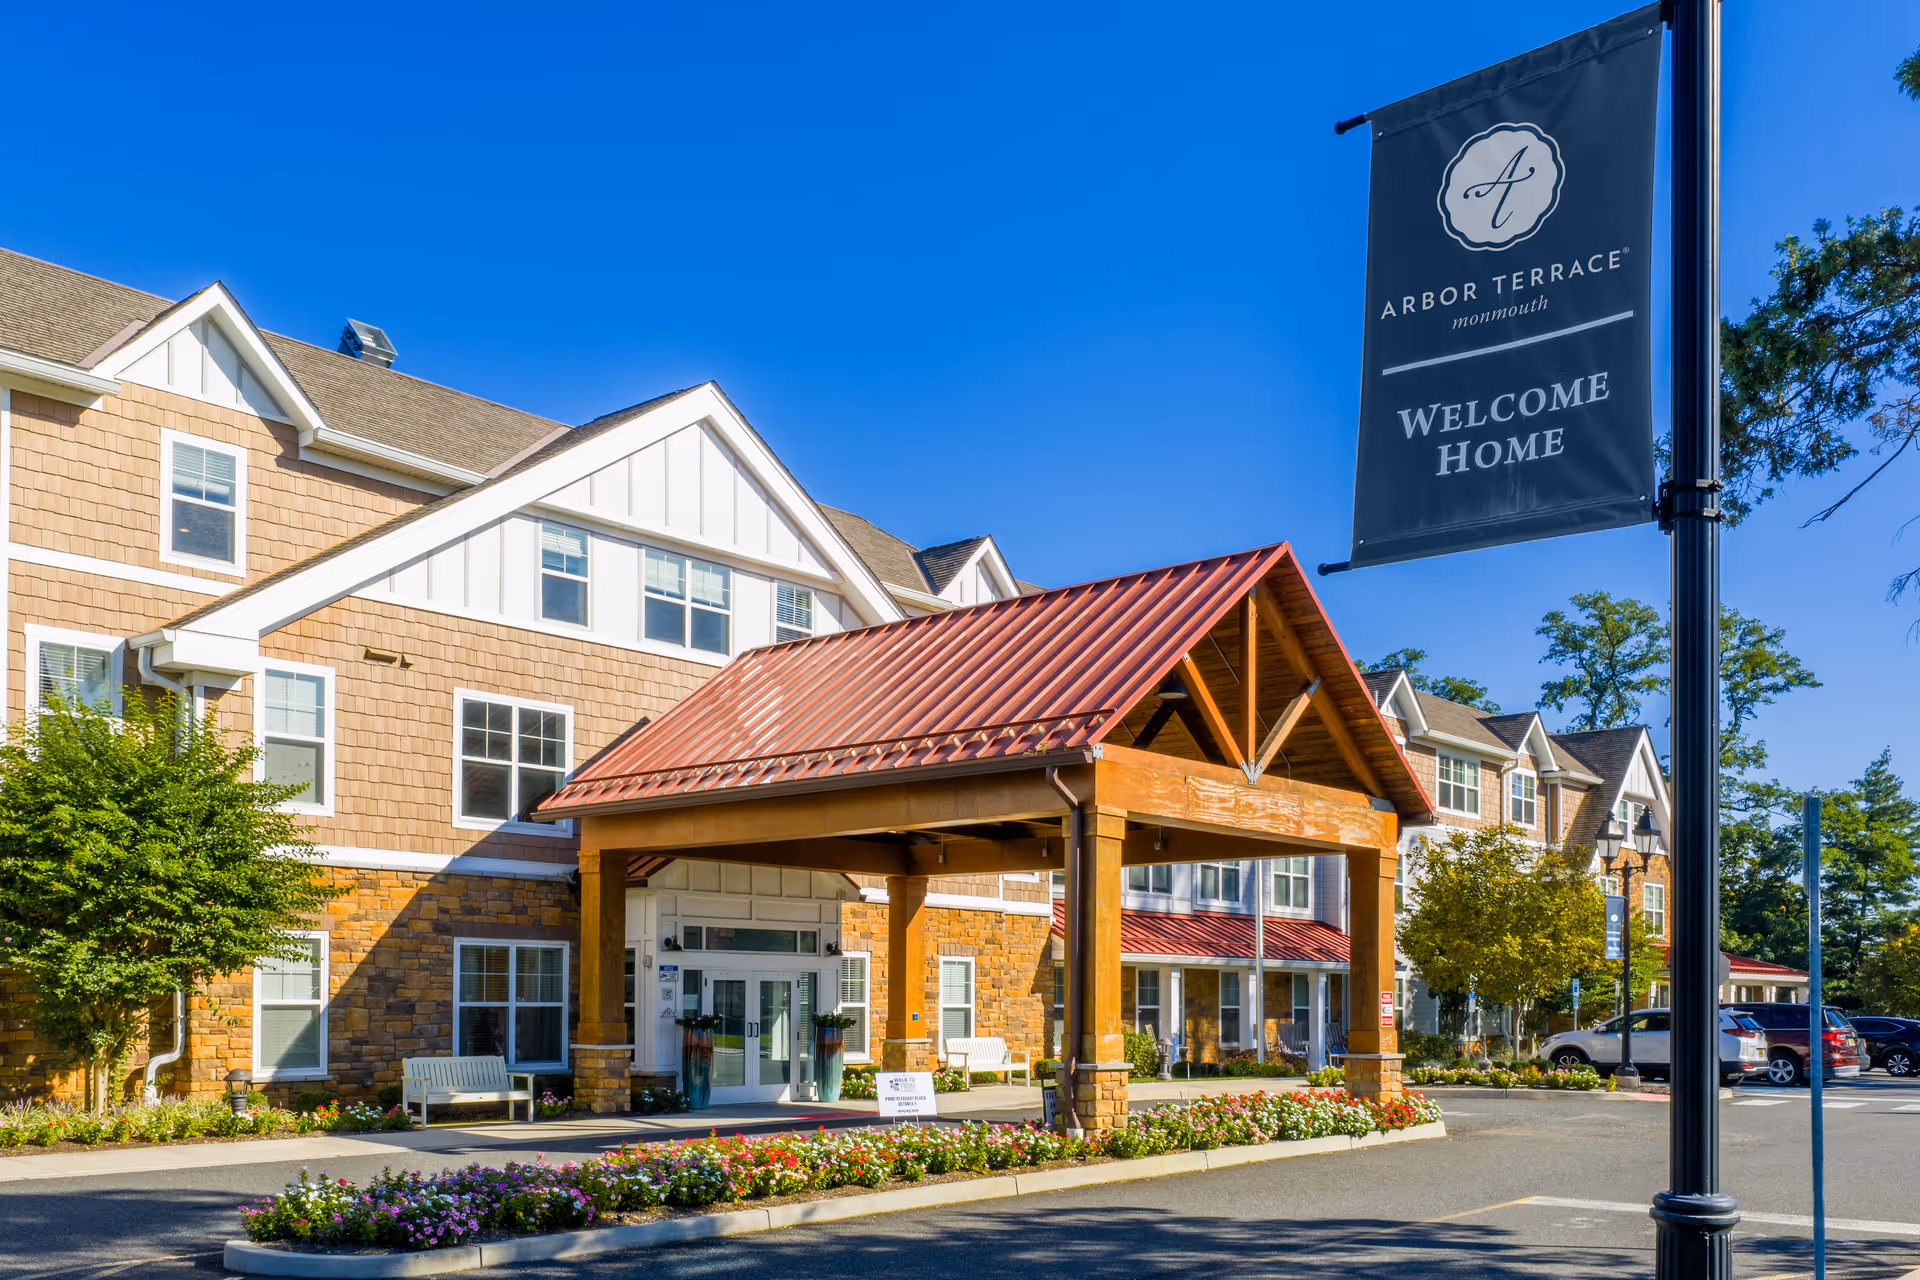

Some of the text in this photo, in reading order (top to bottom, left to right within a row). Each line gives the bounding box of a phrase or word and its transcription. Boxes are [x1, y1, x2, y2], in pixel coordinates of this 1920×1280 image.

[1380, 282, 1477, 320] ARBOR
[1452, 294, 1549, 330] monmouth
[1397, 371, 1610, 440] WELCOME
[1435, 427, 1566, 477] HOME
